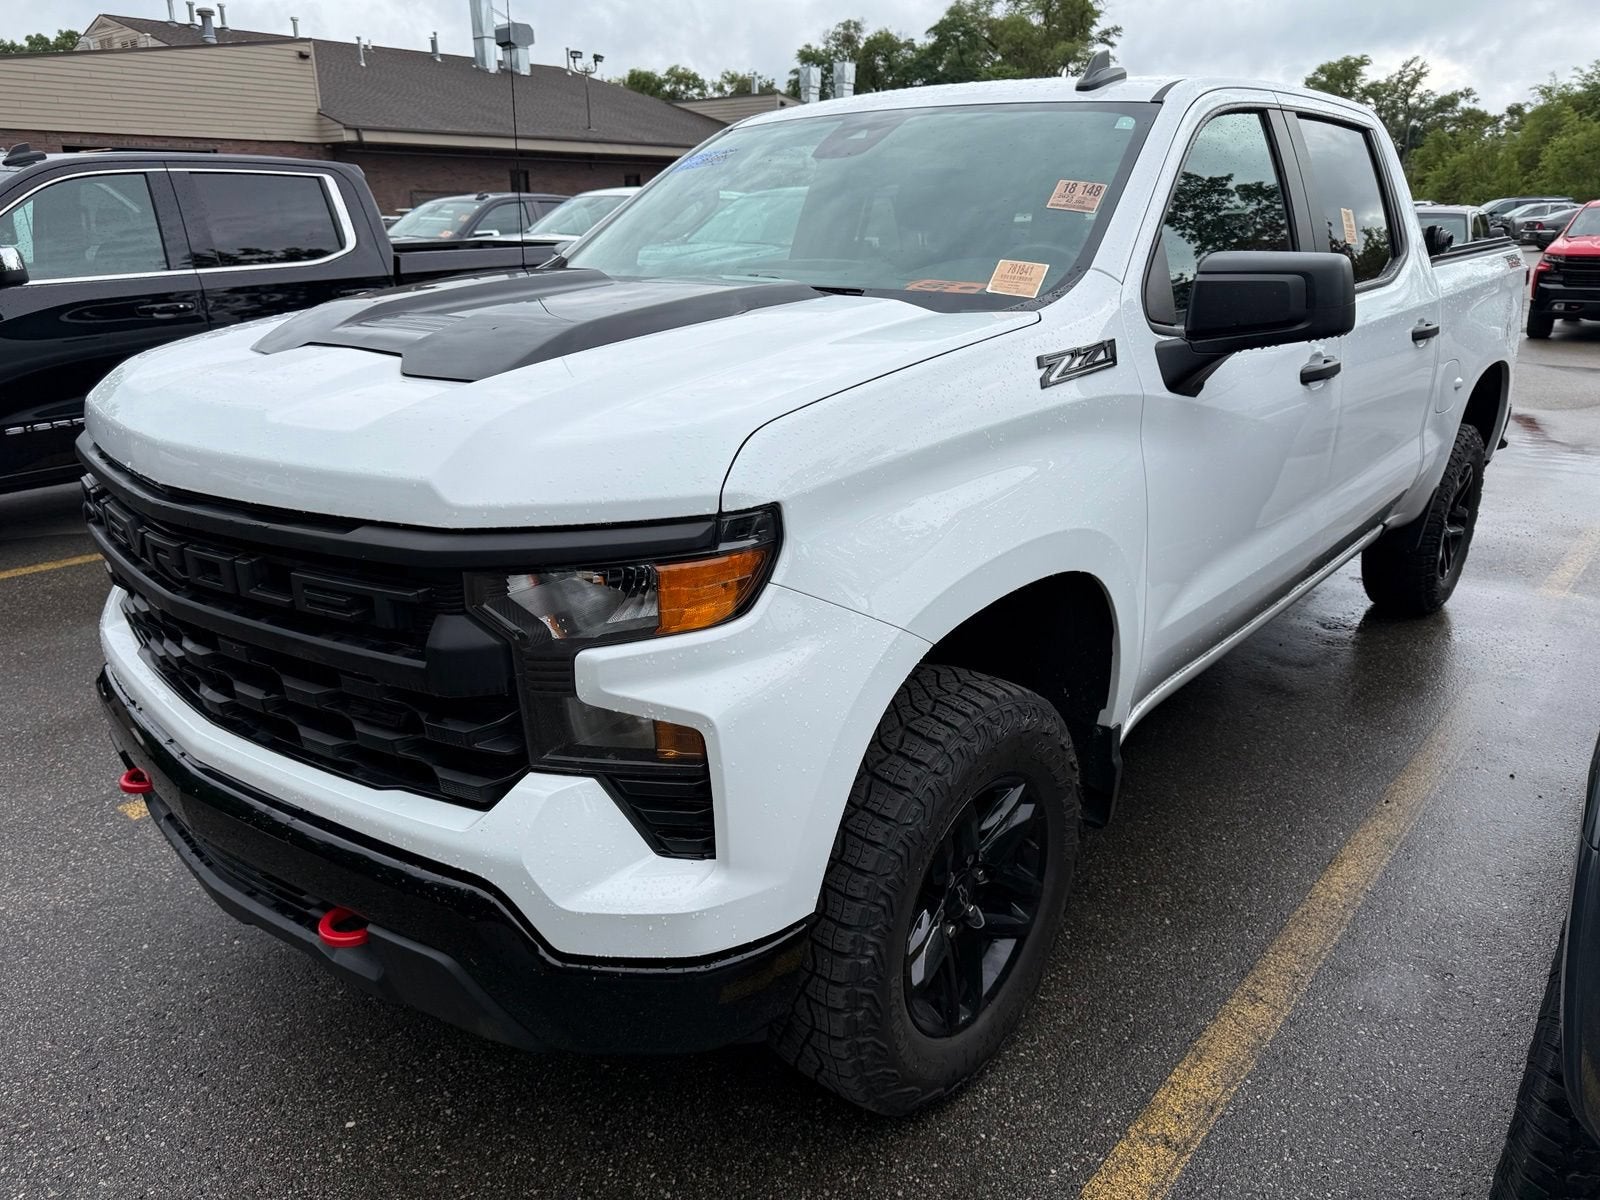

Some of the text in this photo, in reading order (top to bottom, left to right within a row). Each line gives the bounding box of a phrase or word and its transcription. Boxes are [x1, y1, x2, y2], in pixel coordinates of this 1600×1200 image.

[1063, 182, 1103, 197] 18 148
[1036, 338, 1118, 390] Z71
